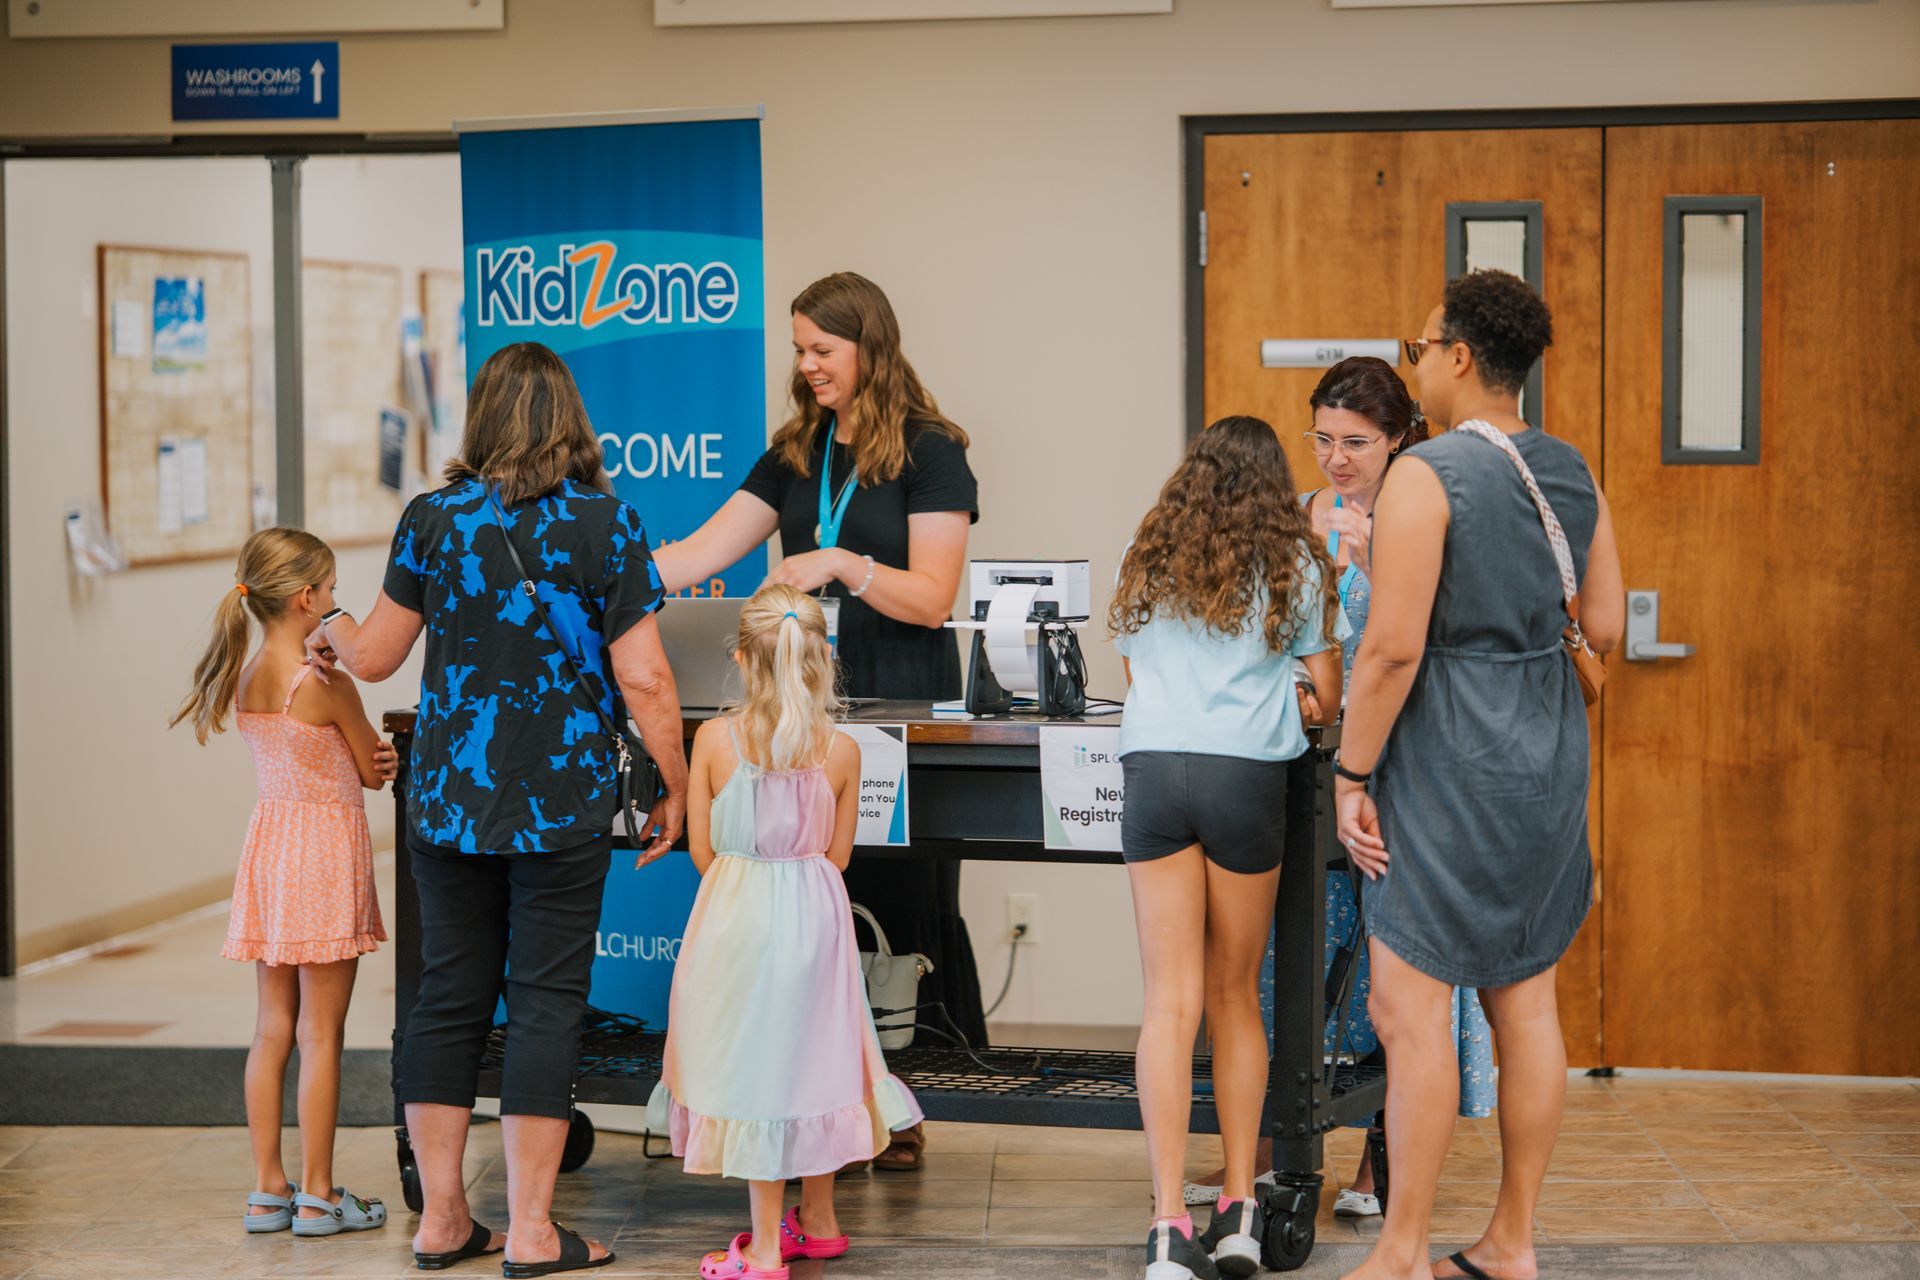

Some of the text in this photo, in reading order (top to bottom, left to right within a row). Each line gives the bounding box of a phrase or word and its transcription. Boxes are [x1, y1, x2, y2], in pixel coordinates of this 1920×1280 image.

[185, 67, 301, 86] WASHROOMS
[477, 240, 739, 330] KidZone
[1315, 347, 1344, 361] GYM
[1090, 753, 1110, 763] SPL
[862, 779, 895, 790] phone
[876, 794, 895, 803] You
